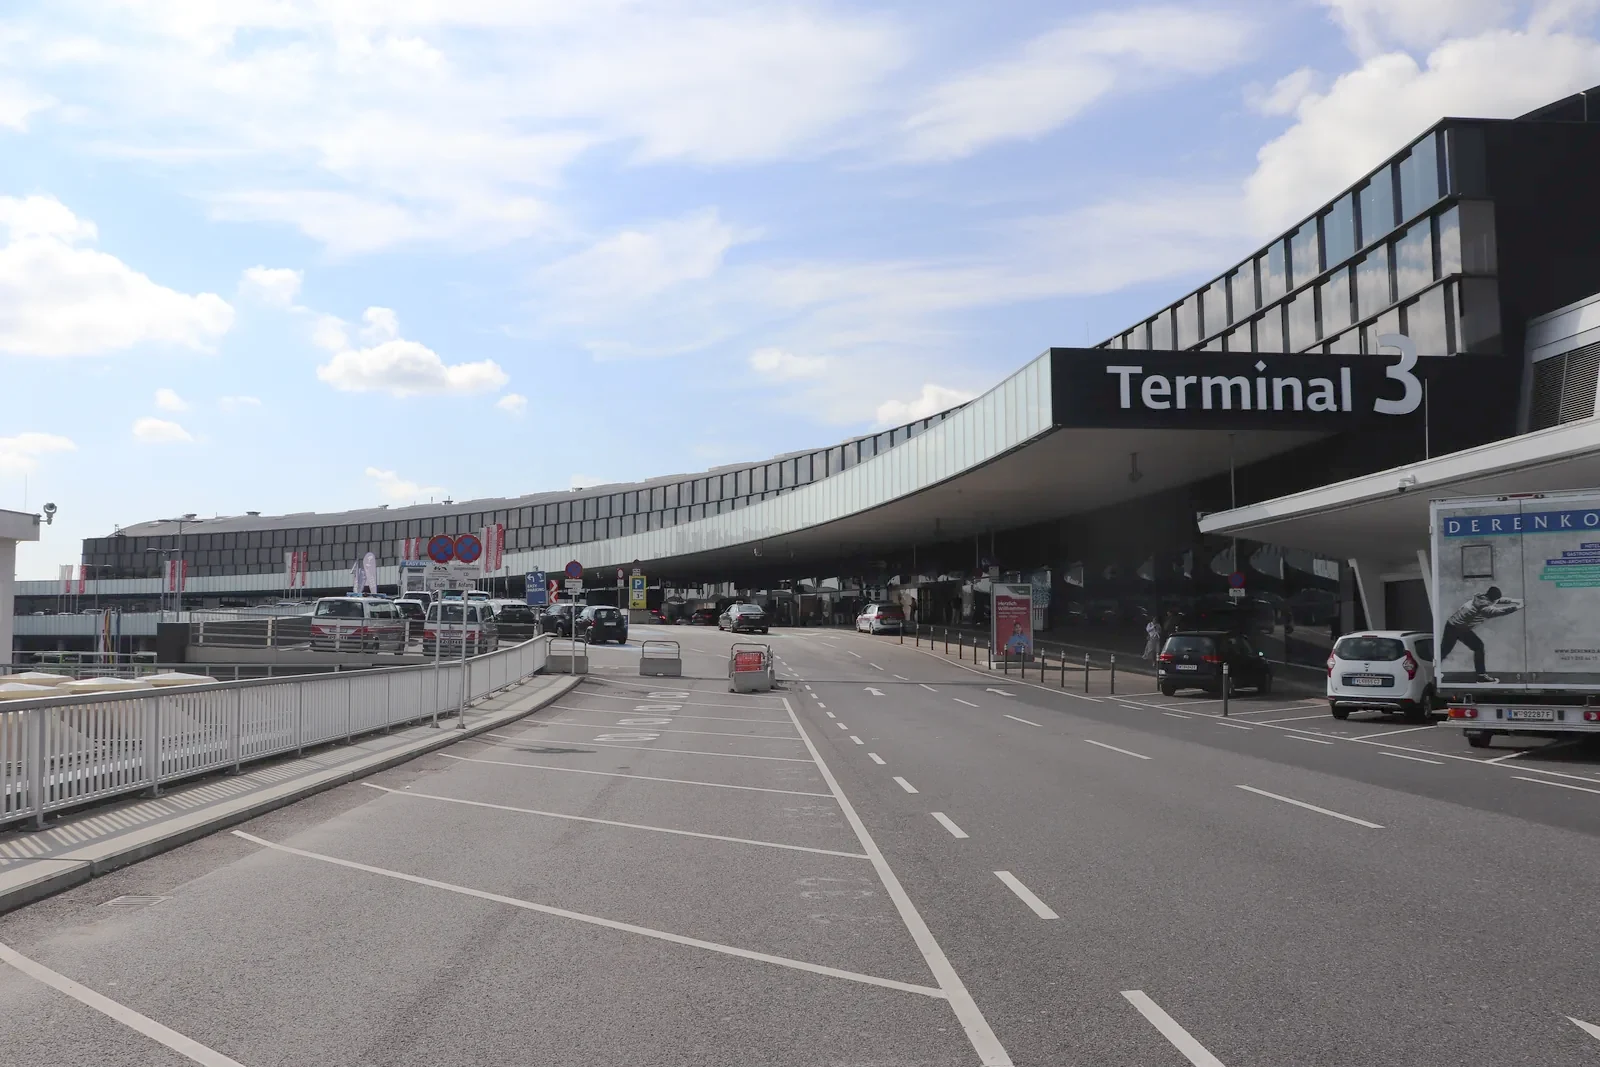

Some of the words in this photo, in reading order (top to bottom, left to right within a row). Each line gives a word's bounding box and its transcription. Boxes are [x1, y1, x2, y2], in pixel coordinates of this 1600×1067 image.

[1106, 360, 1352, 412] Terminal
[1373, 333, 1423, 416] 3
[1448, 513, 1600, 534] DERENKO
